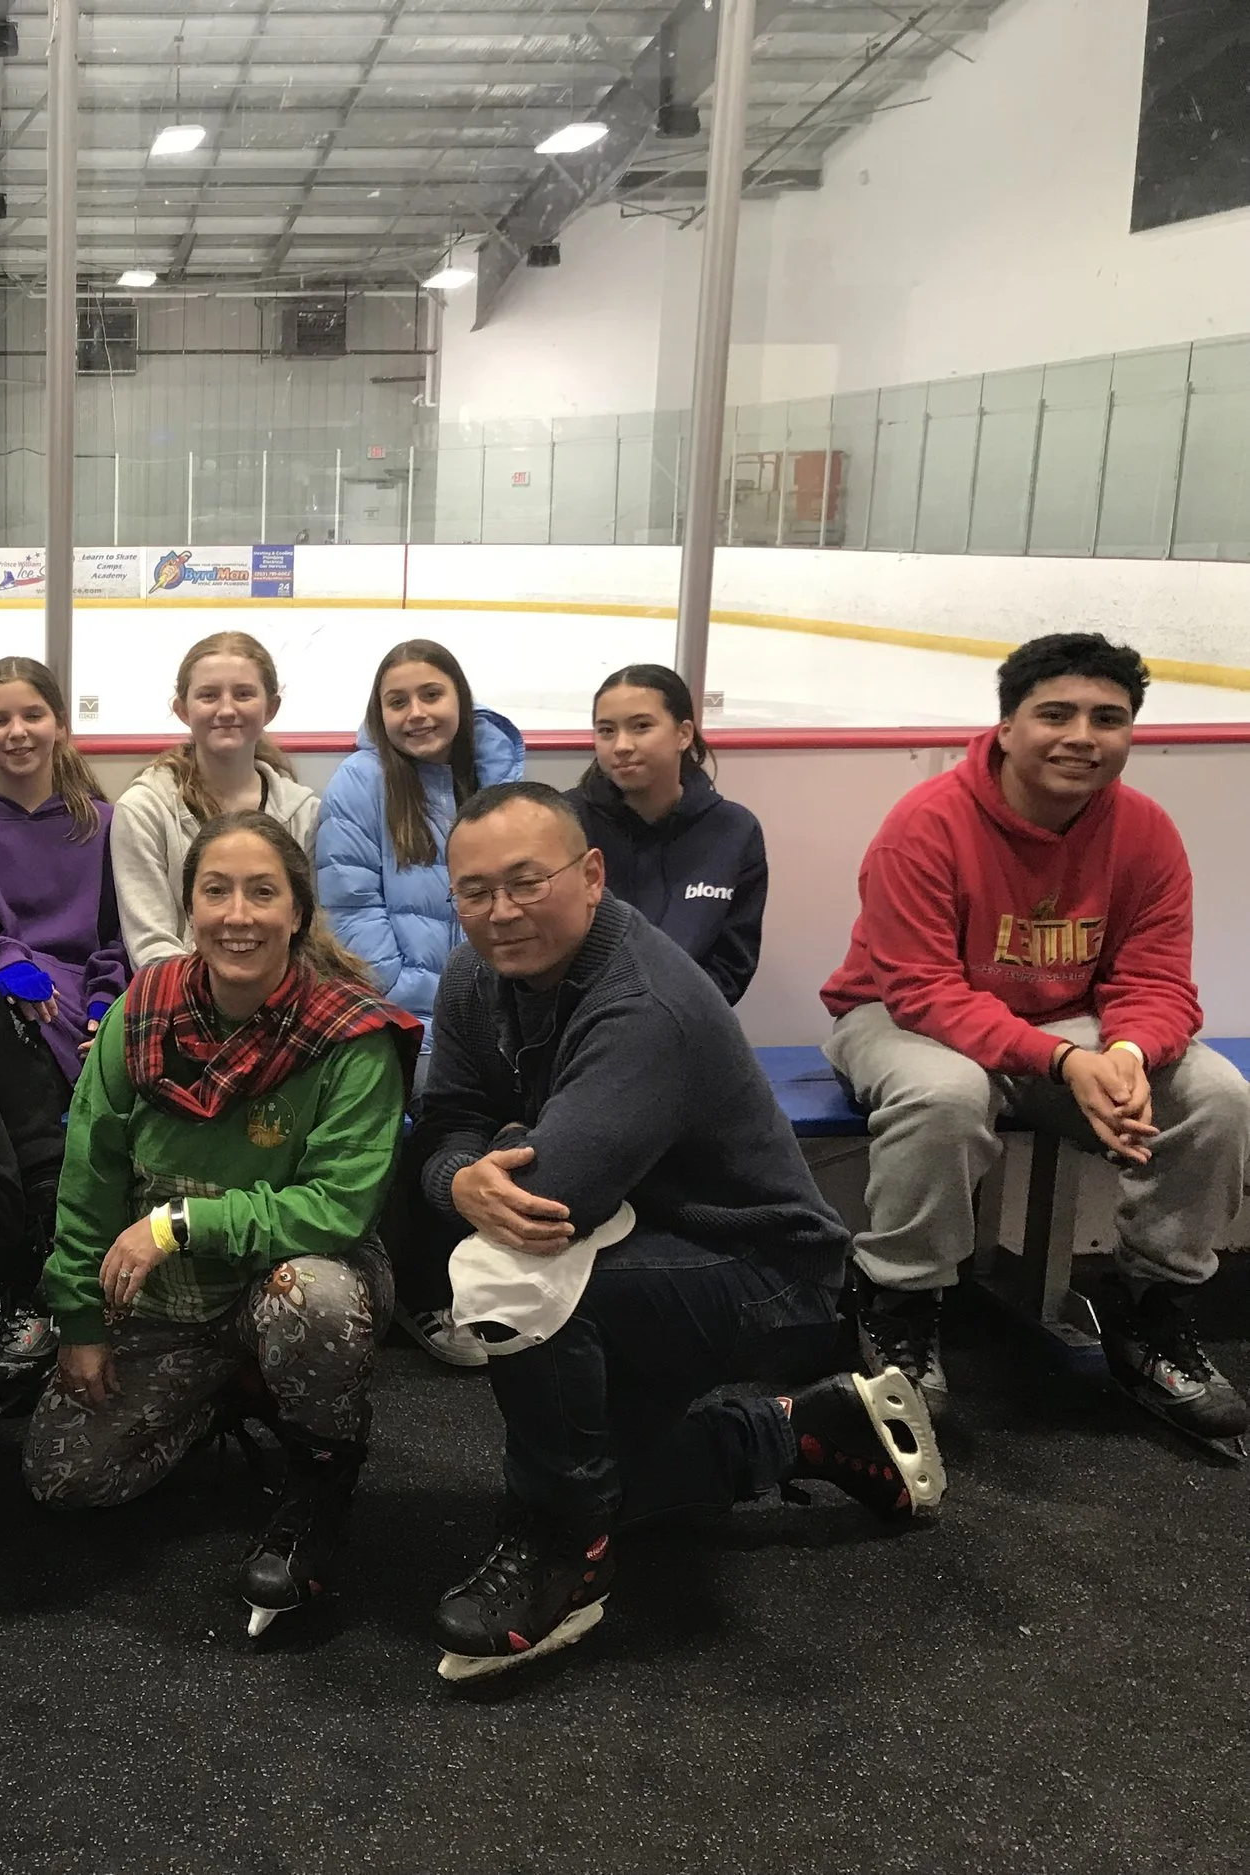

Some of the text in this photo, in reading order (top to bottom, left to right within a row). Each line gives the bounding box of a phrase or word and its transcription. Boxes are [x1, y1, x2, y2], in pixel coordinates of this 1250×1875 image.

[17, 565, 34, 579] Ice
[96, 563, 123, 571] Camps
[90, 573, 128, 581] Academy
[183, 566, 250, 584] ByrdMan
